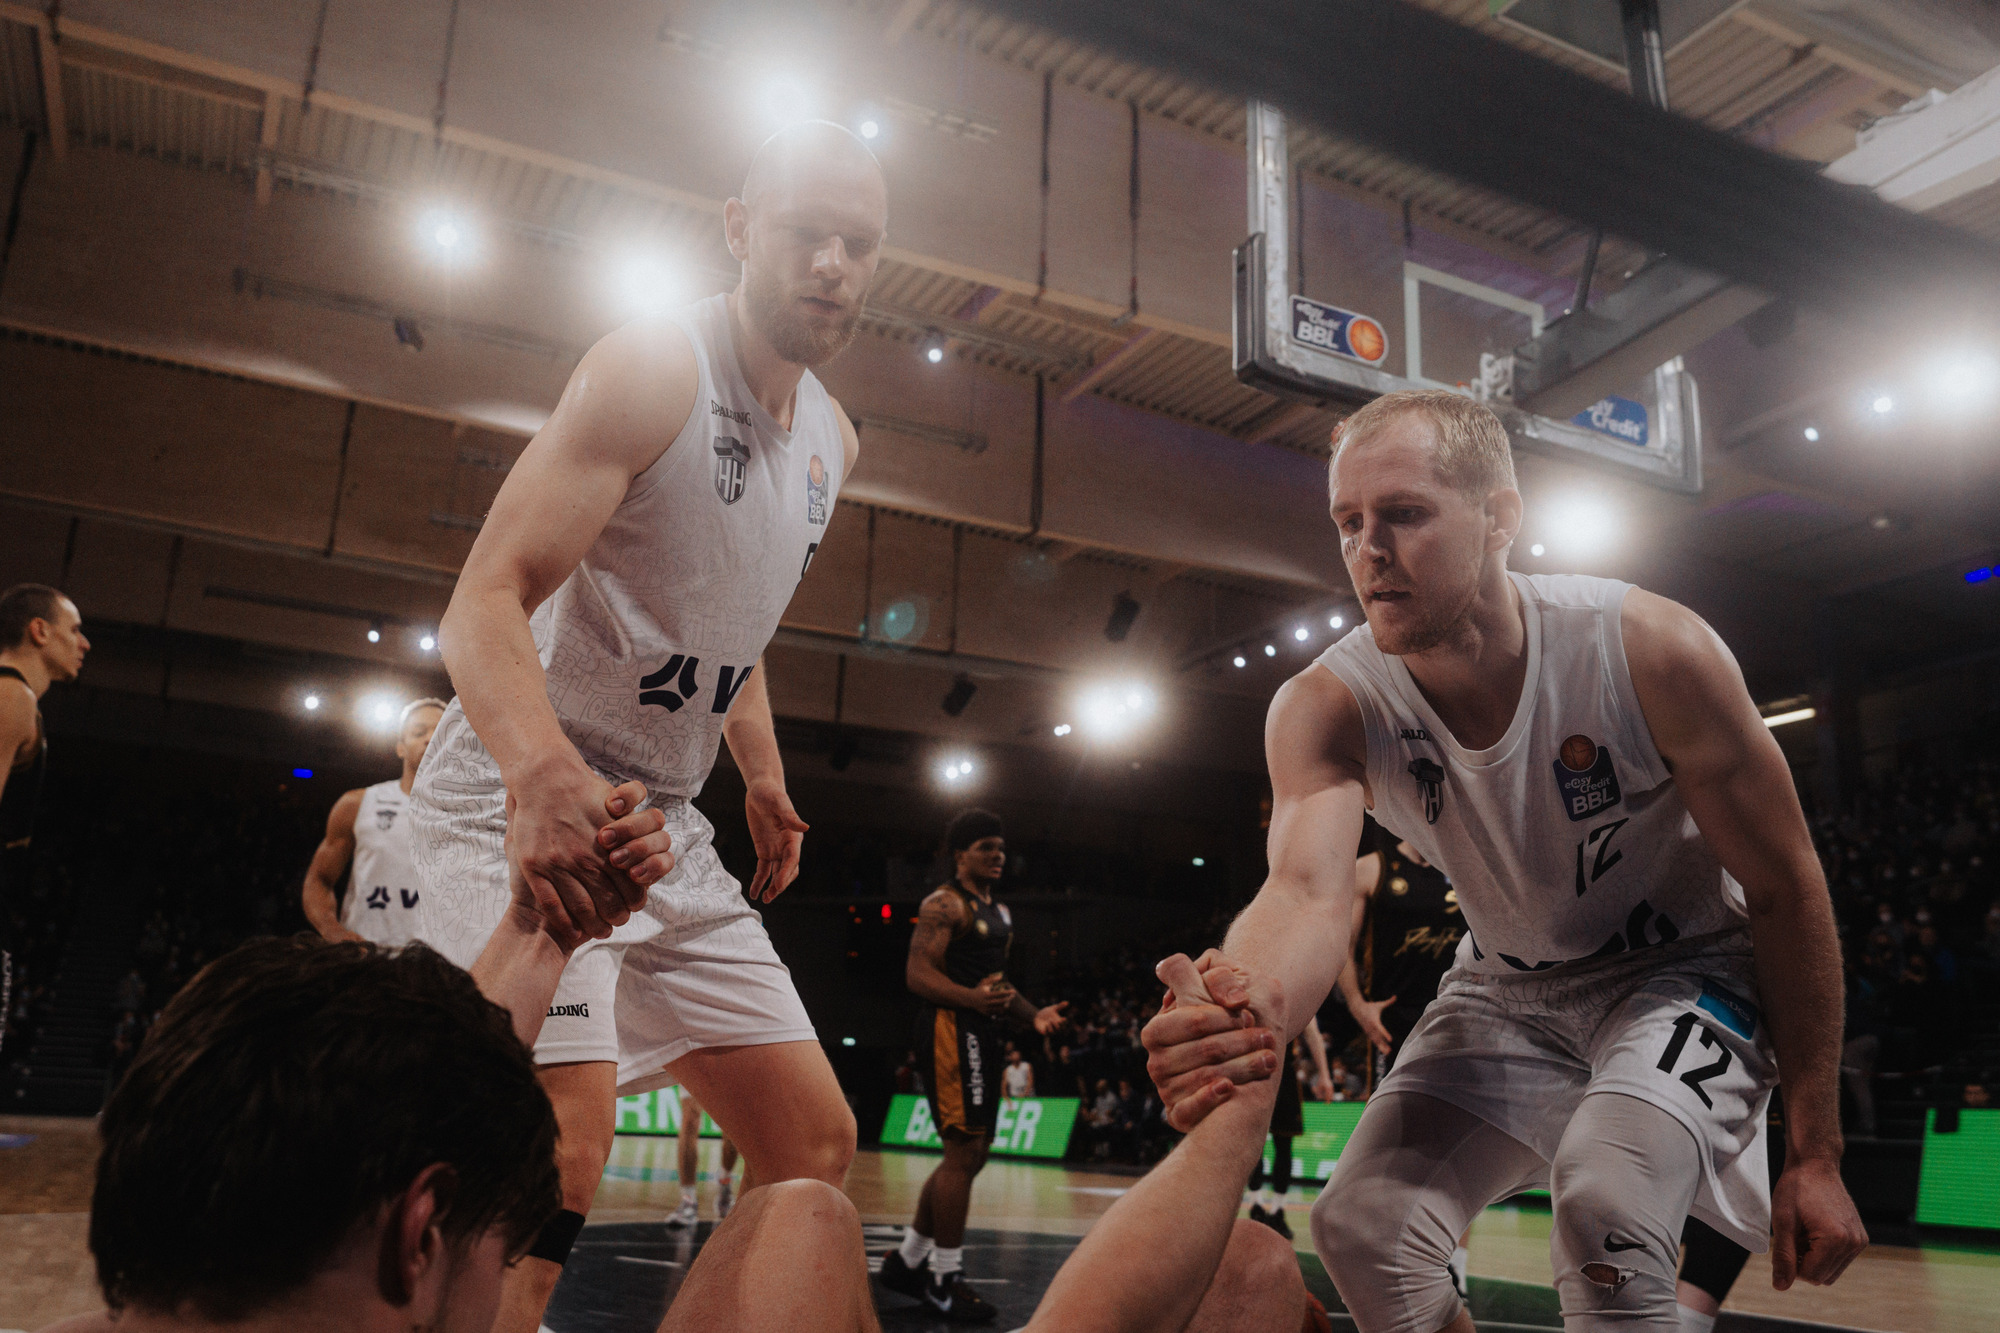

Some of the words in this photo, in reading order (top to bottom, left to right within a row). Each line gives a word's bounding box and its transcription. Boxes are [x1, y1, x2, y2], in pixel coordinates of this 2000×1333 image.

[1296, 320, 1340, 350] BBL
[1572, 787, 1615, 816] BBL
[1575, 817, 1630, 898] 12
[1656, 1011, 1732, 1111] 12
